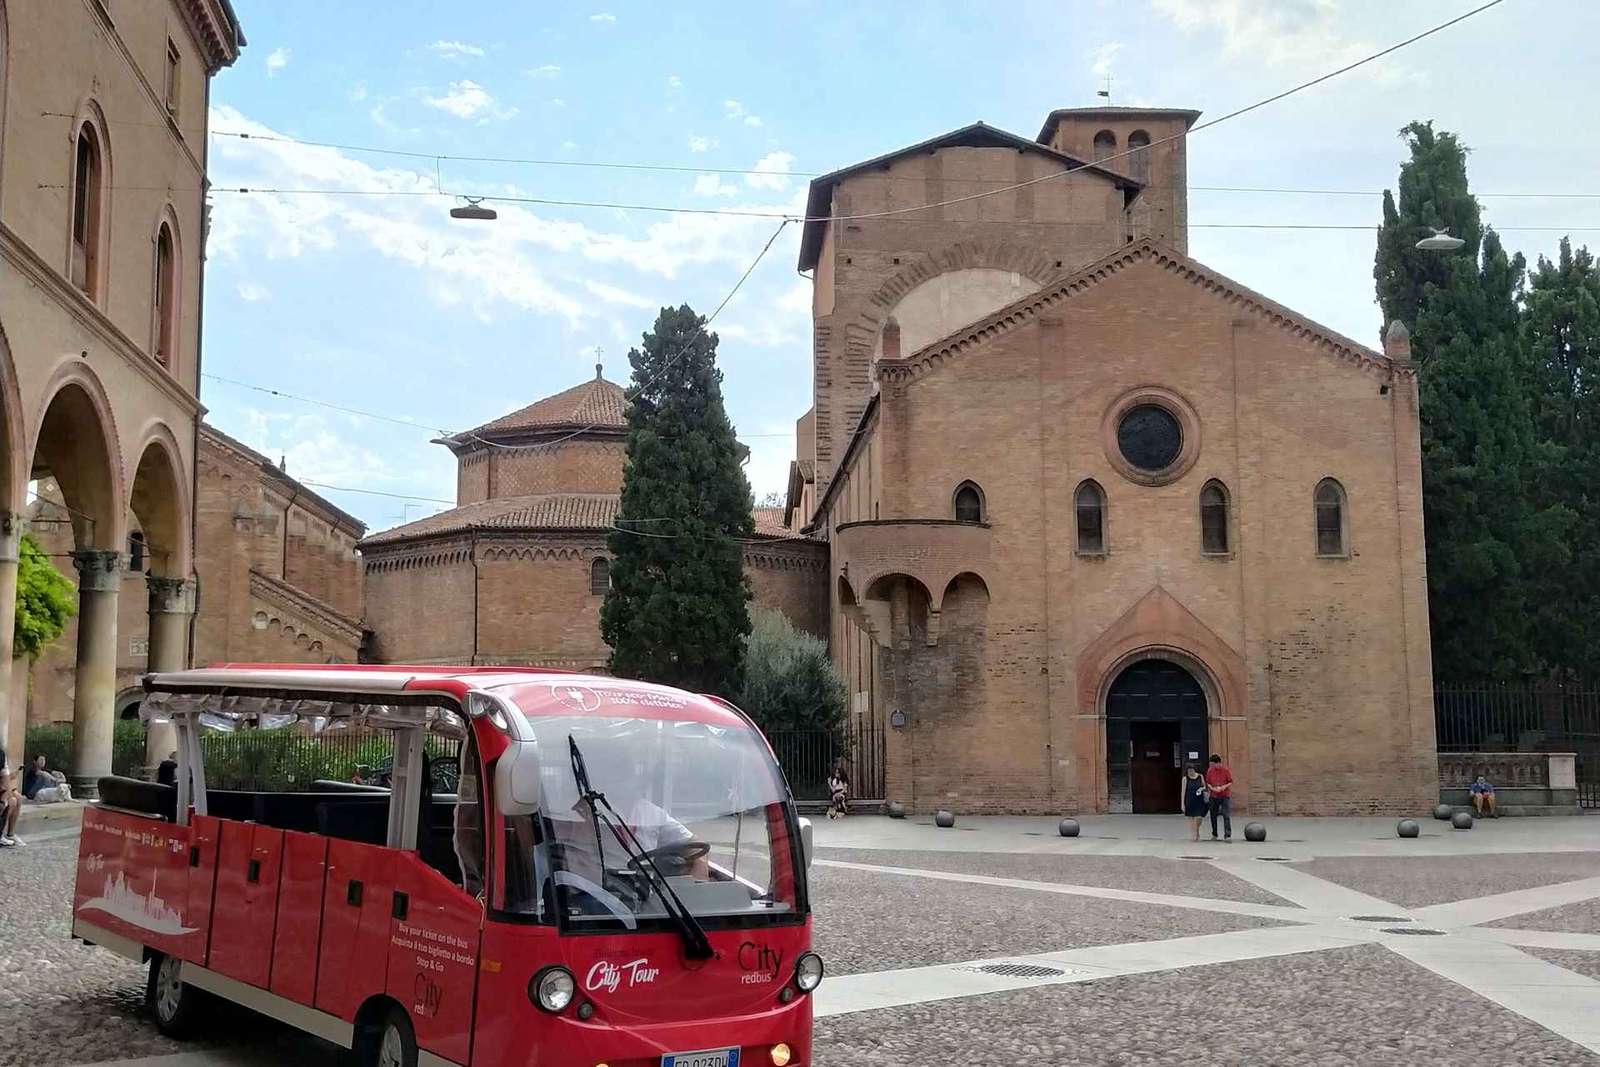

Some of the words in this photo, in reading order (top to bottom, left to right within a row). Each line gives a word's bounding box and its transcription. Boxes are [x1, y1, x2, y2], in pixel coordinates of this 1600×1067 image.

[438, 935, 446, 943] on
[447, 935, 456, 946] the
[458, 937, 468, 949] bus
[417, 956, 429, 968] Stop
[436, 962, 444, 972] Go
[418, 943, 427, 952] tuo
[429, 946, 451, 959] biglietto
[457, 952, 474, 966] bordo
[738, 941, 784, 979] City
[586, 960, 621, 993] City
[622, 958, 660, 988] Tour
[741, 971, 772, 985] redbus
[415, 972, 442, 1016] City
